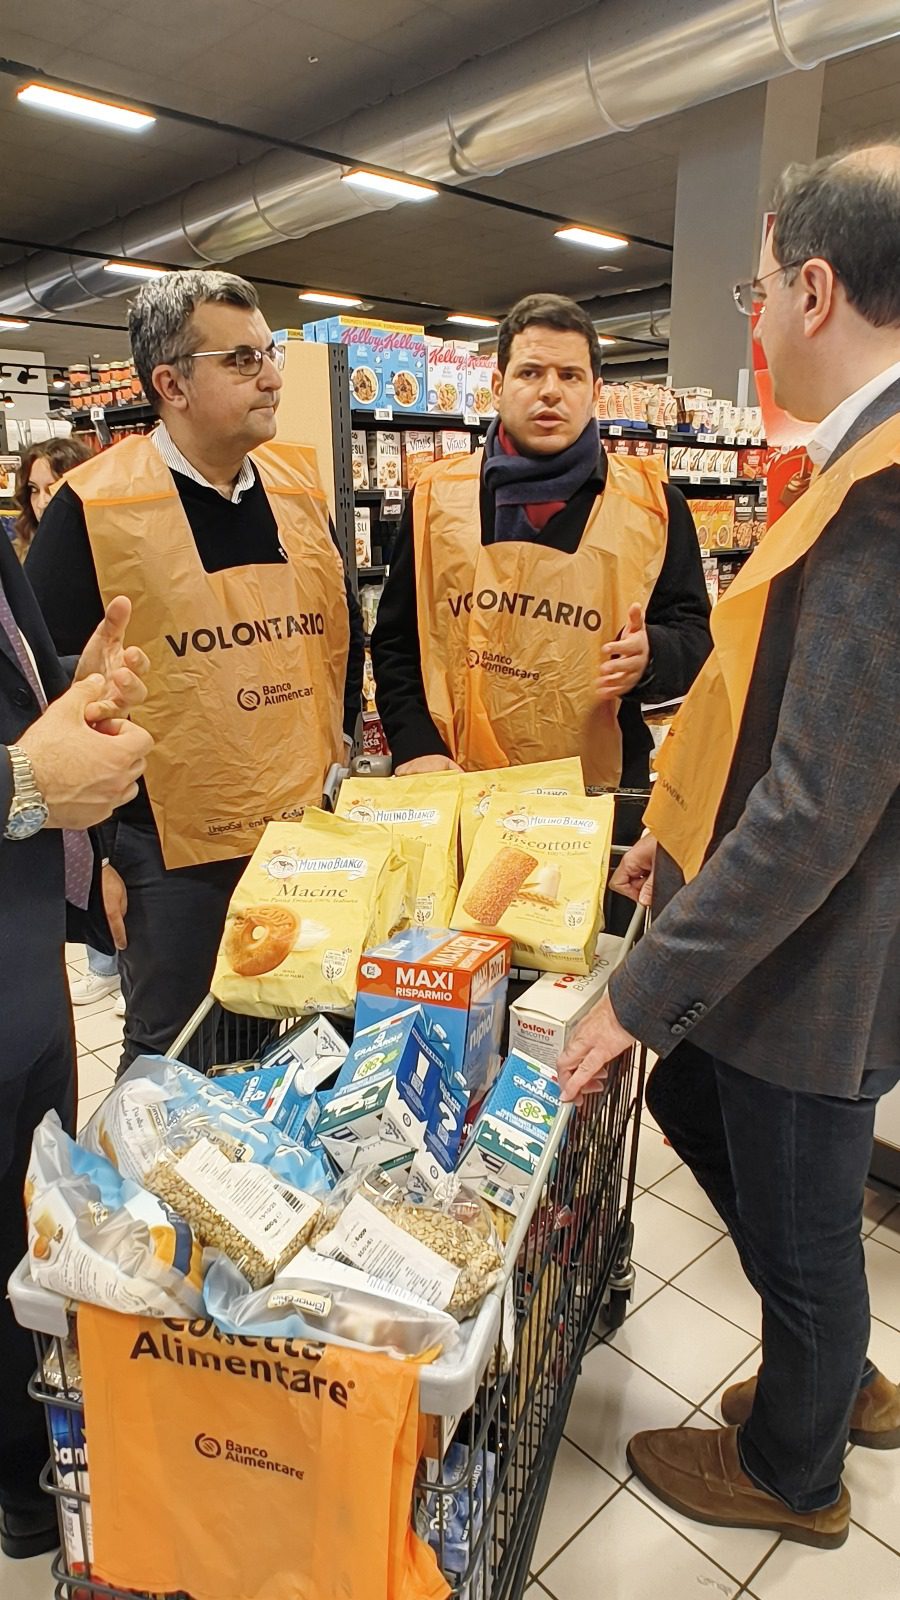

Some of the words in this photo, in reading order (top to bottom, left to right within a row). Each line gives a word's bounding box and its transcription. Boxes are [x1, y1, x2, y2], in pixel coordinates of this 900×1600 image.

[165, 613, 325, 658] VOLONTARIO
[262, 682, 292, 696] Banco
[264, 686, 315, 707] Alimentar
[500, 832, 592, 852] Biscottone
[276, 883, 349, 898] Macine
[395, 966, 454, 991] MAXI
[394, 986, 453, 1001] RISPARMIO
[513, 1075, 562, 1107] GRANAROL
[130, 1330, 349, 1410] Alimentare
[225, 1439, 268, 1458] Banco
[225, 1451, 305, 1481] Alimentare
